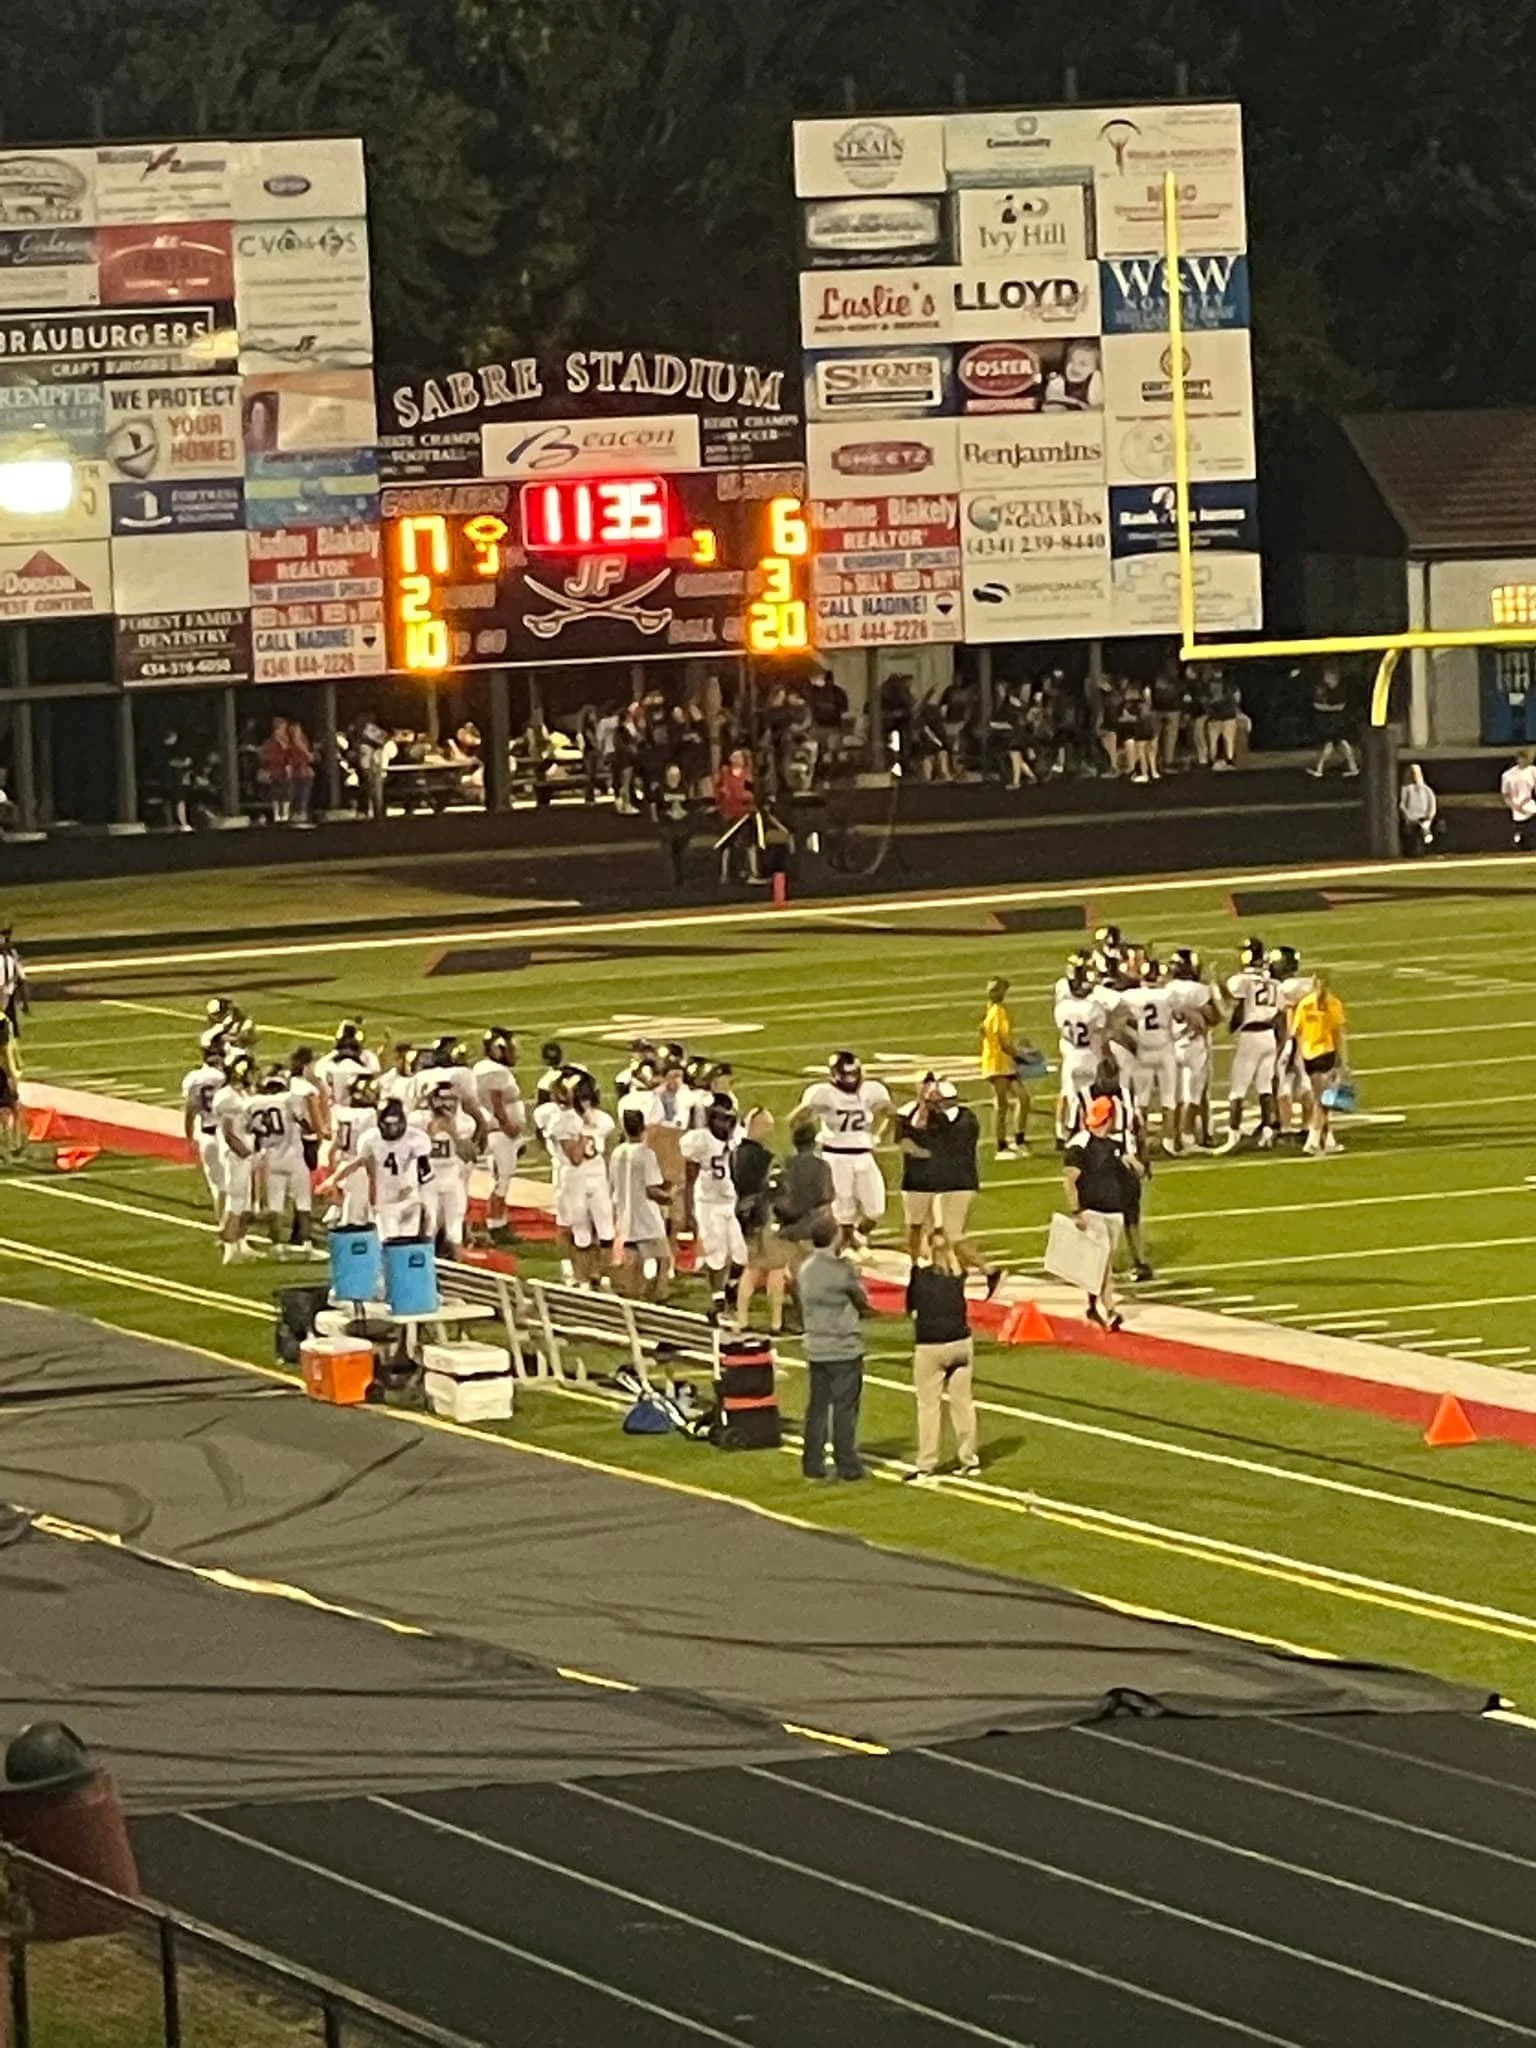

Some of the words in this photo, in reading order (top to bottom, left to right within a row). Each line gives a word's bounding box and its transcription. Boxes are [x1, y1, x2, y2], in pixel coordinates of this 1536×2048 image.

[979, 226, 1017, 254] Ivy
[1024, 222, 1066, 247] Hill
[954, 279, 1079, 311] LLOYD
[965, 358, 1034, 378] FOSTER
[110, 389, 141, 410] WE
[147, 385, 236, 408] PROTECT
[393, 358, 542, 428] SABRE
[566, 351, 784, 411] STADIUM
[167, 413, 222, 436] YOUR
[506, 425, 676, 469] Beacon
[770, 497, 808, 556] 6
[691, 528, 717, 563] 3
[564, 555, 627, 597] JF
[760, 556, 793, 603] 3
[400, 575, 432, 622] 2
[818, 597, 857, 618] CALL
[750, 600, 808, 651] 20
[255, 632, 292, 652] CALL
[406, 620, 449, 669] 10
[1143, 1003, 1160, 1031] 2
[836, 1109, 867, 1131] 72
[383, 1151, 399, 1176] 4
[711, 1154, 726, 1181] 5
